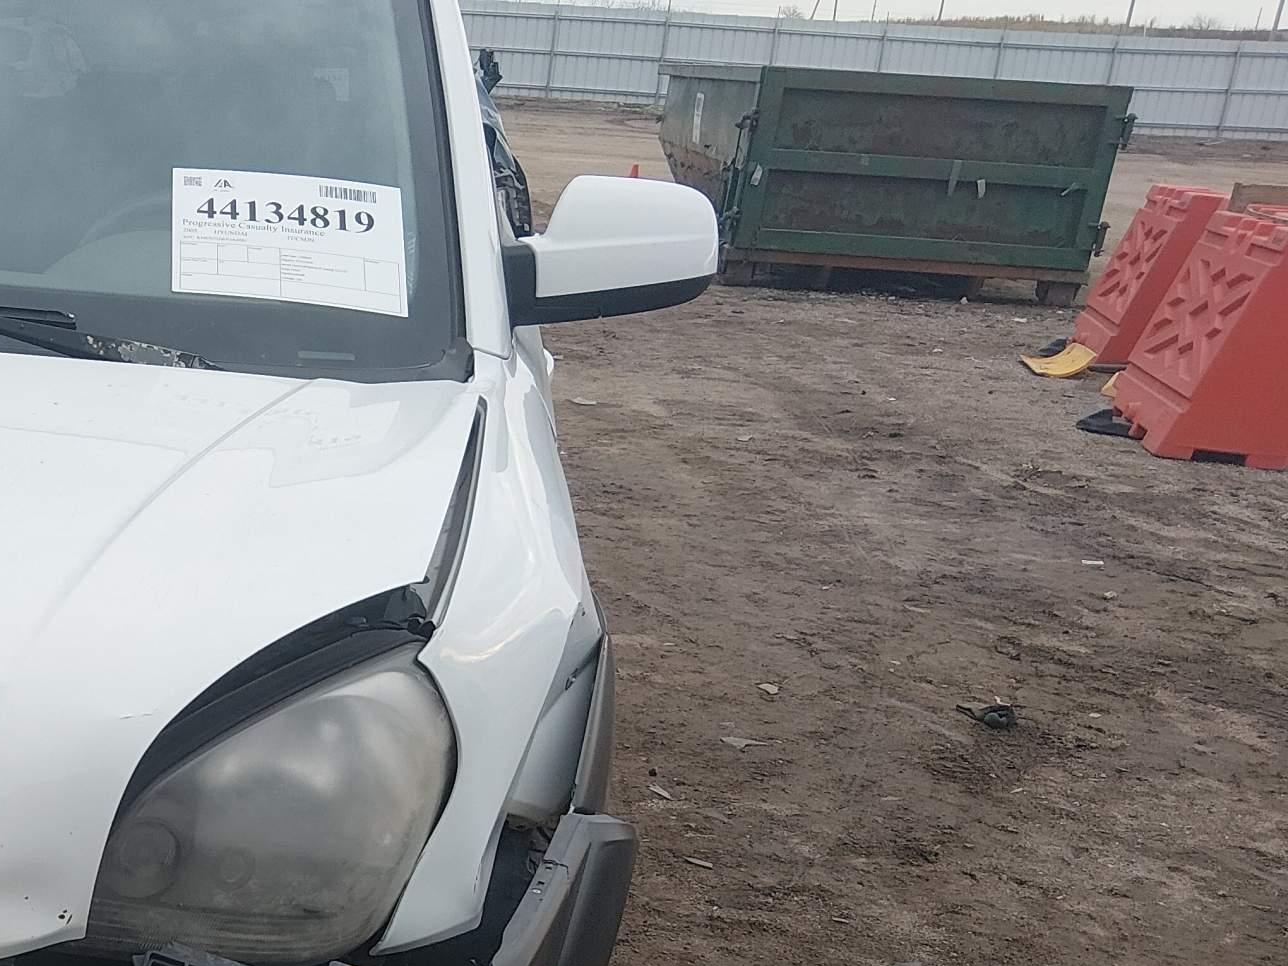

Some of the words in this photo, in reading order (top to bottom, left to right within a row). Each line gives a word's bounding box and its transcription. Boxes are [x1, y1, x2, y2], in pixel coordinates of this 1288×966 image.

[182, 218, 236, 229] Progressive
[238, 222, 278, 233] Casualty
[281, 225, 327, 237] Insurance
[197, 197, 375, 233] 44134819
